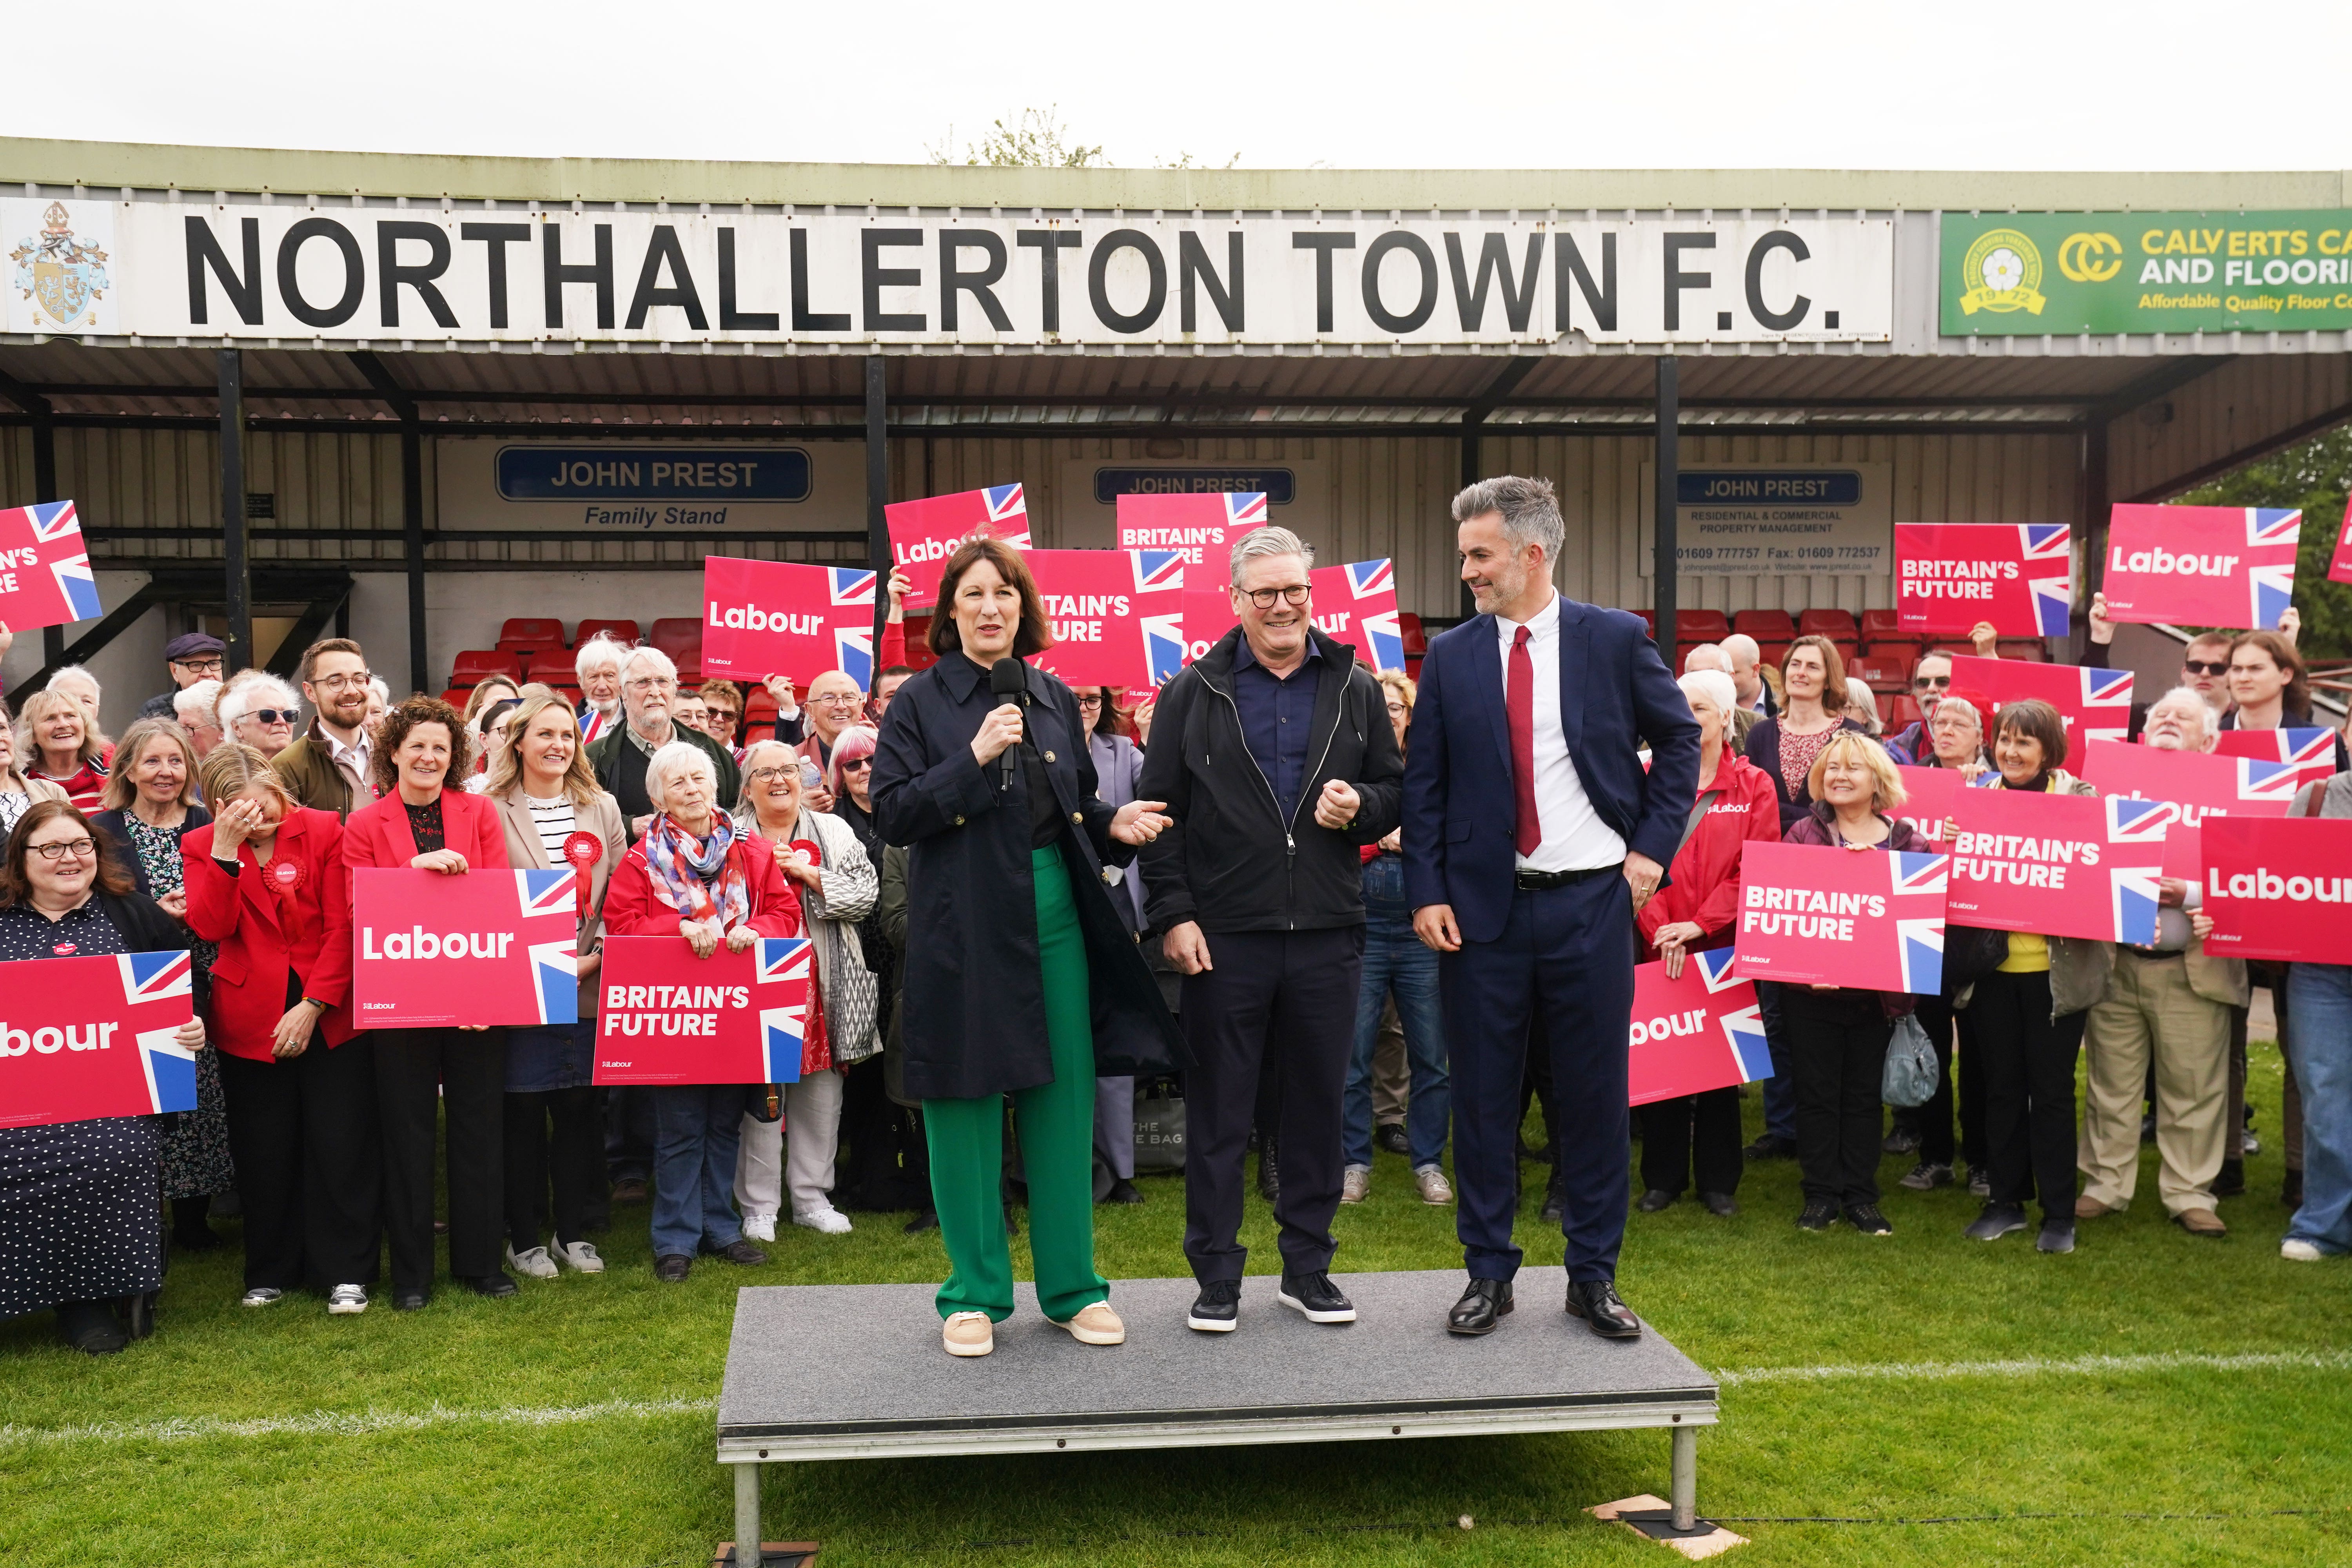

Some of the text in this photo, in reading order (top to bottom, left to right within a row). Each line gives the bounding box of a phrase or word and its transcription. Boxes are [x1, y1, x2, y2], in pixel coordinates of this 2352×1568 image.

[2141, 229, 2308, 256] CALVERTS
[185, 216, 1839, 332] NORTHALLERTON TOWN F.C.
[2139, 258, 2352, 286] AND FLOORI
[1975, 291, 2030, 303] 19 72
[2138, 293, 2220, 309] Affordable
[2225, 295, 2284, 313] Quality
[2287, 294, 2331, 309] Floor
[551, 461, 758, 487] JOHN PREST
[1129, 477, 1260, 493] JOHN PREST
[1705, 480, 1829, 497] JOHN PREST
[585, 507, 727, 529] Family Stand
[1691, 511, 1841, 521] RESIDENTIAL & COMMERCIAL
[1123, 527, 1224, 545] BRITAIN'S
[1700, 524, 1833, 534] PROPERTY MANAGEMENT
[897, 534, 988, 565] Labo
[1677, 546, 1880, 559] 01609 777757 Fax: 01609 772537
[1902, 560, 2019, 579] BRITAIN'S
[2112, 546, 2239, 577] Labour
[1903, 580, 1993, 599] FUTURE
[710, 601, 824, 636] Labour
[1716, 802, 1751, 813] Labour
[1955, 831, 2100, 866] BRITAIN'S
[1952, 857, 2066, 889] FUTURE
[1745, 886, 1886, 917] BRITAIN'S
[1955, 902, 1978, 910] Labour
[1743, 911, 1854, 941] FUTURE
[363, 925, 514, 960] Labour
[607, 985, 750, 1009] BRITAIN'S
[604, 1013, 717, 1036] FUTURE
[1151, 1134, 1183, 1144] BAG
